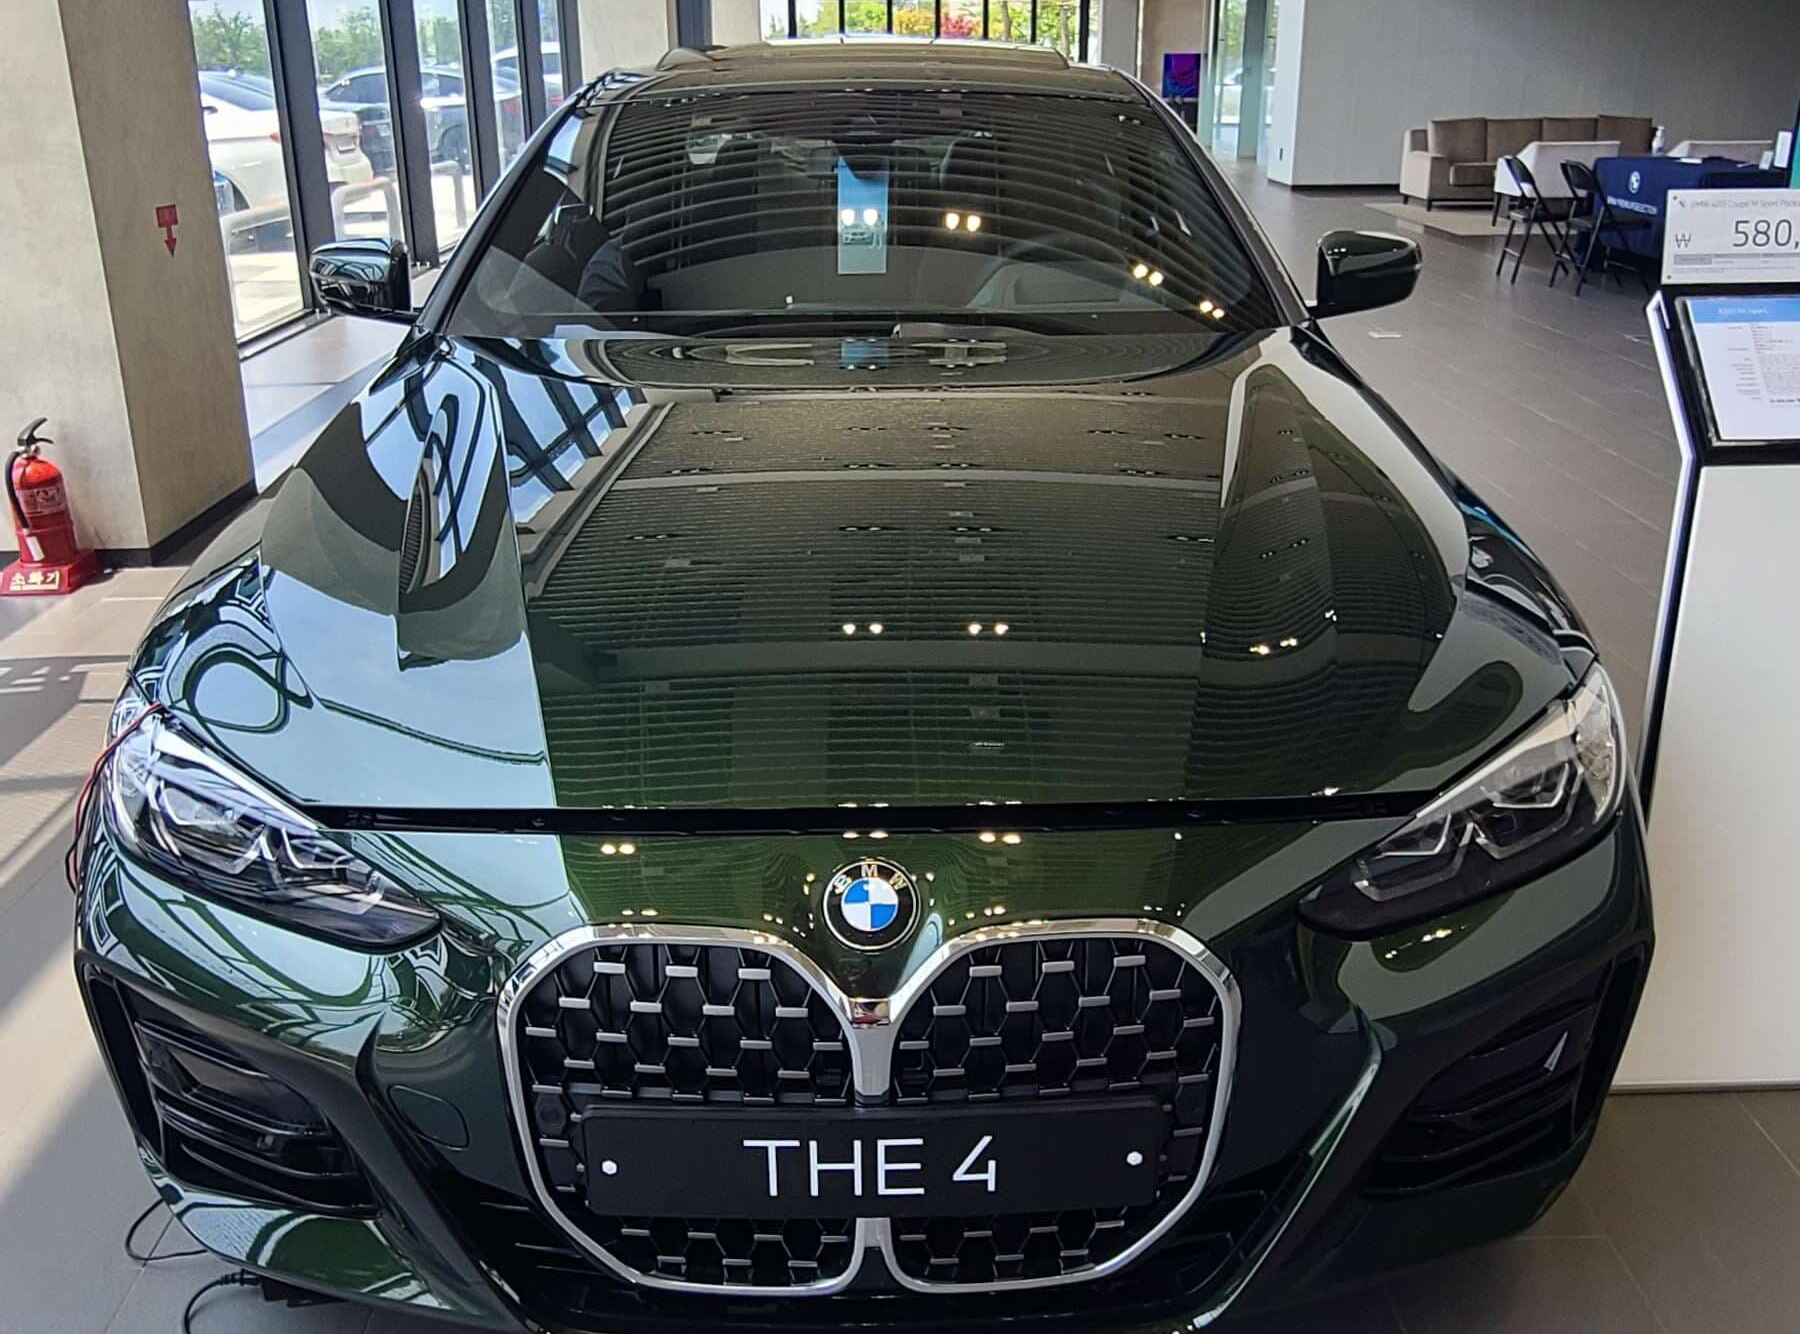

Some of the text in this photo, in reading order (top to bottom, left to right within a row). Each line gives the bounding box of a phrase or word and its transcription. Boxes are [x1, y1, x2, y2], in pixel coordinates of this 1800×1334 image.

[10, 570, 60, 586] 소화기
[833, 864, 909, 895] BMW
[743, 1135, 997, 1197] THE 4
